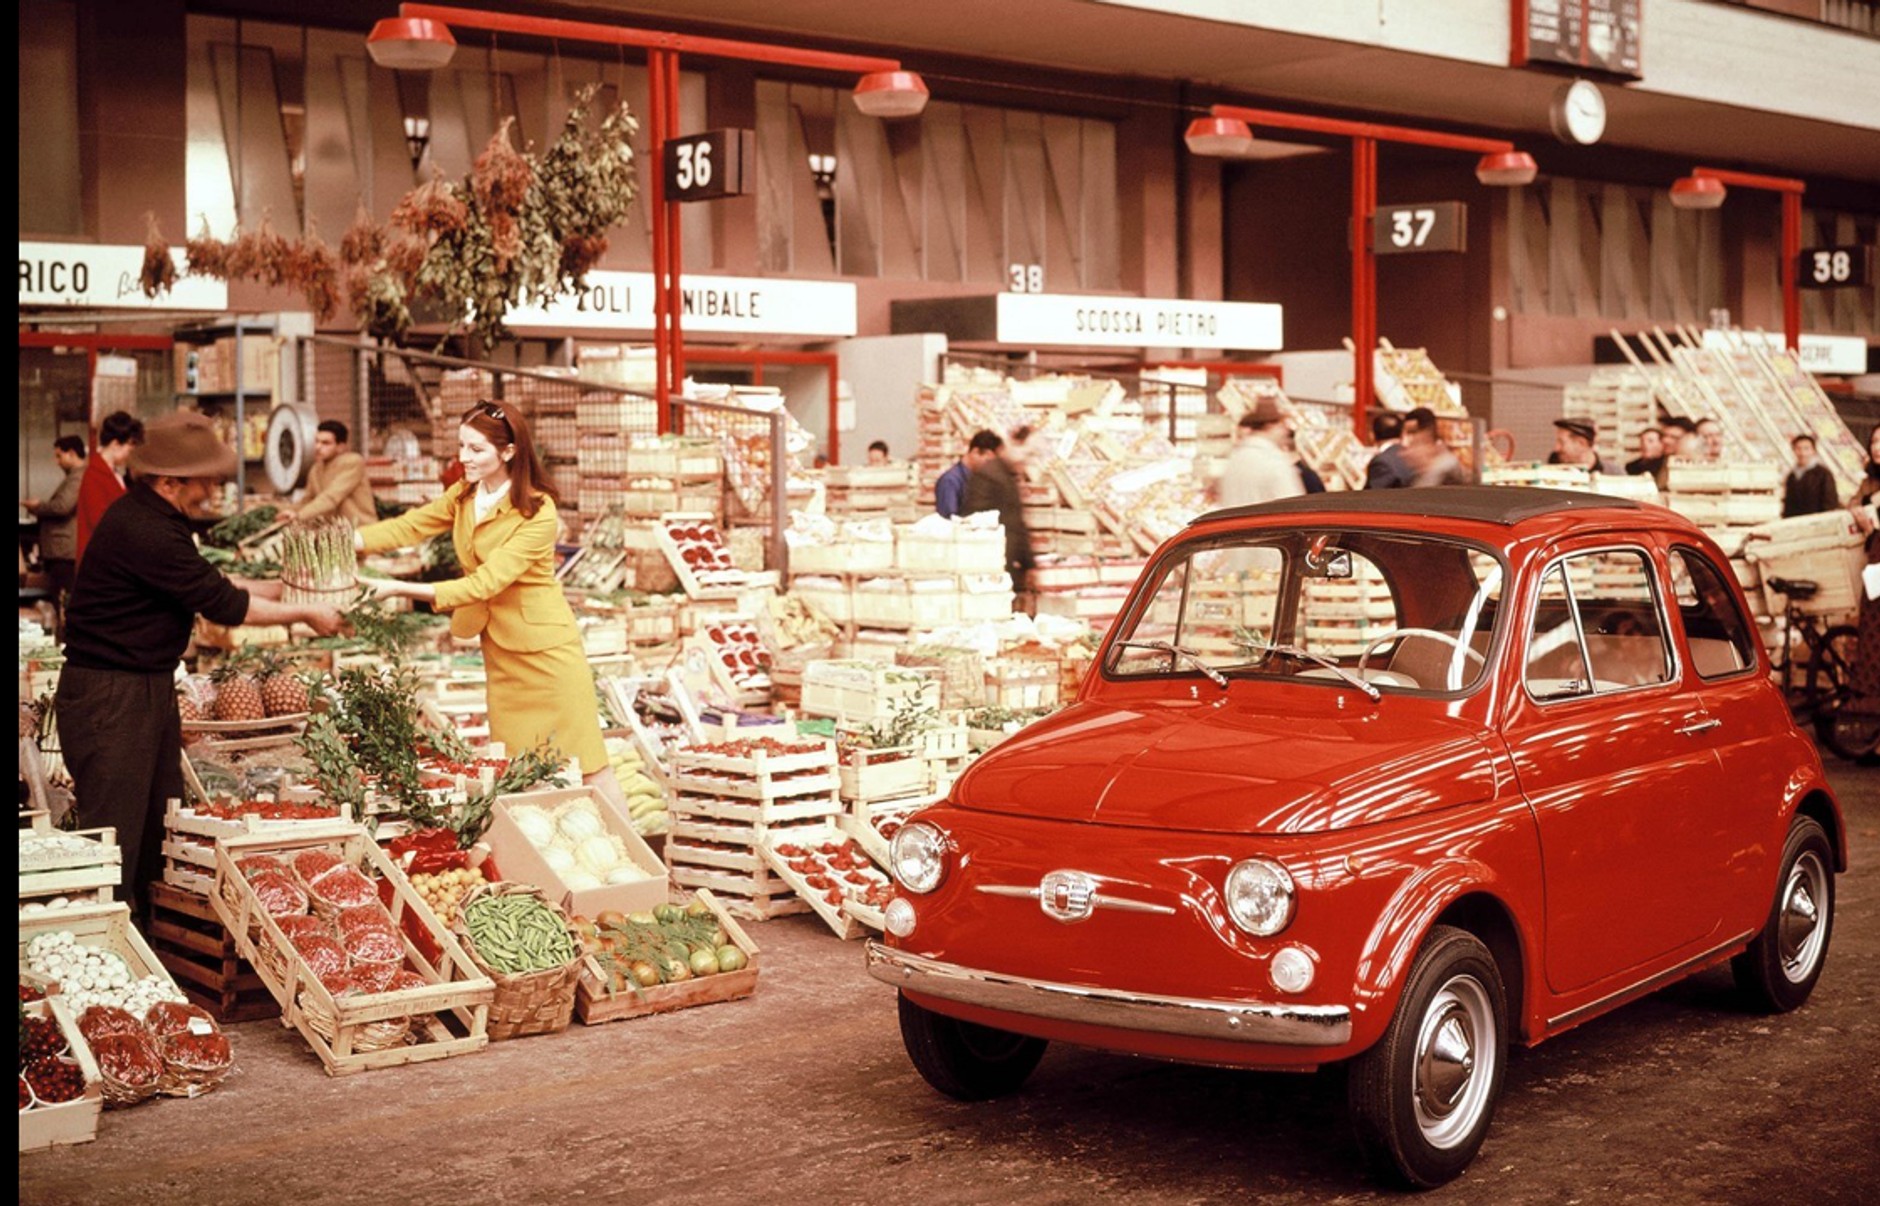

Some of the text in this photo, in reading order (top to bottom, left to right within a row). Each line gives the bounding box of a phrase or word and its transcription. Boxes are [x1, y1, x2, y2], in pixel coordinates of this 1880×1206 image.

[676, 140, 713, 190] 36
[1391, 209, 1436, 248] 37
[1009, 264, 1042, 293] 38
[1813, 250, 1850, 283] 38
[1076, 308, 1217, 336] SCOSSA PIETRO
